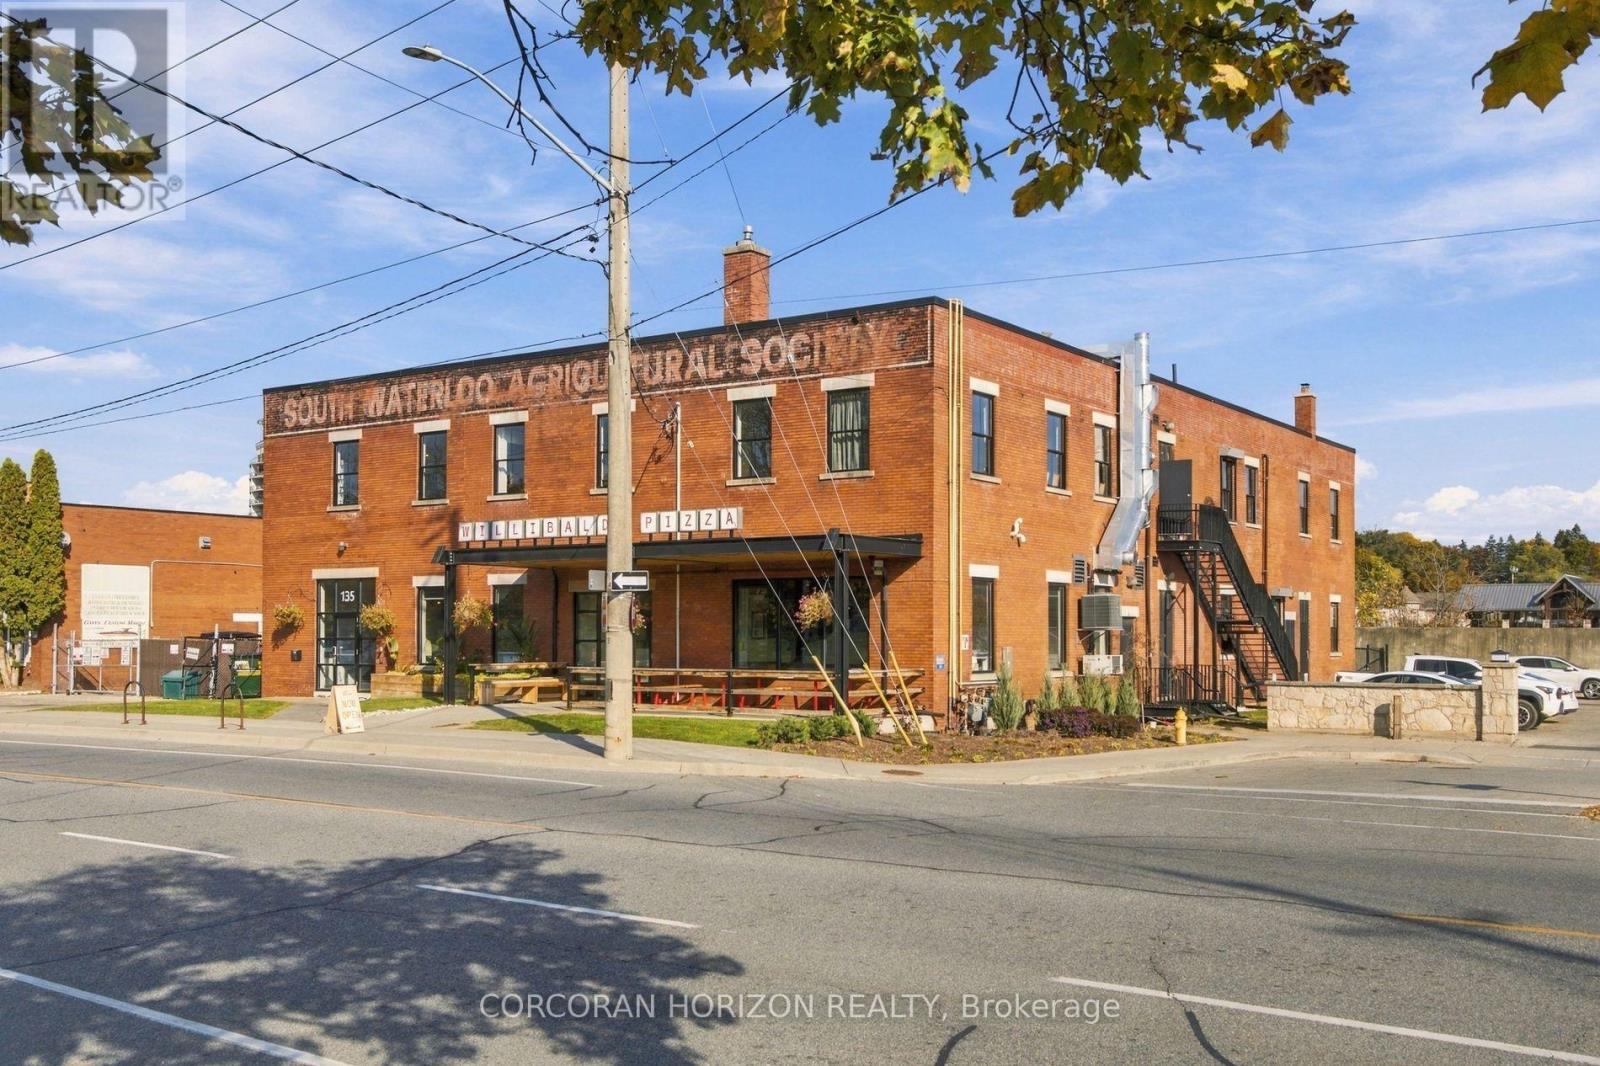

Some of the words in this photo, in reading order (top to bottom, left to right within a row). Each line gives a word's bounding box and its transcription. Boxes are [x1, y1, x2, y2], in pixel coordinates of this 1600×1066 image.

[509, 343, 724, 399] AGRICUURAL
[645, 511, 734, 529] PIZZA
[340, 590, 355, 602] 135
